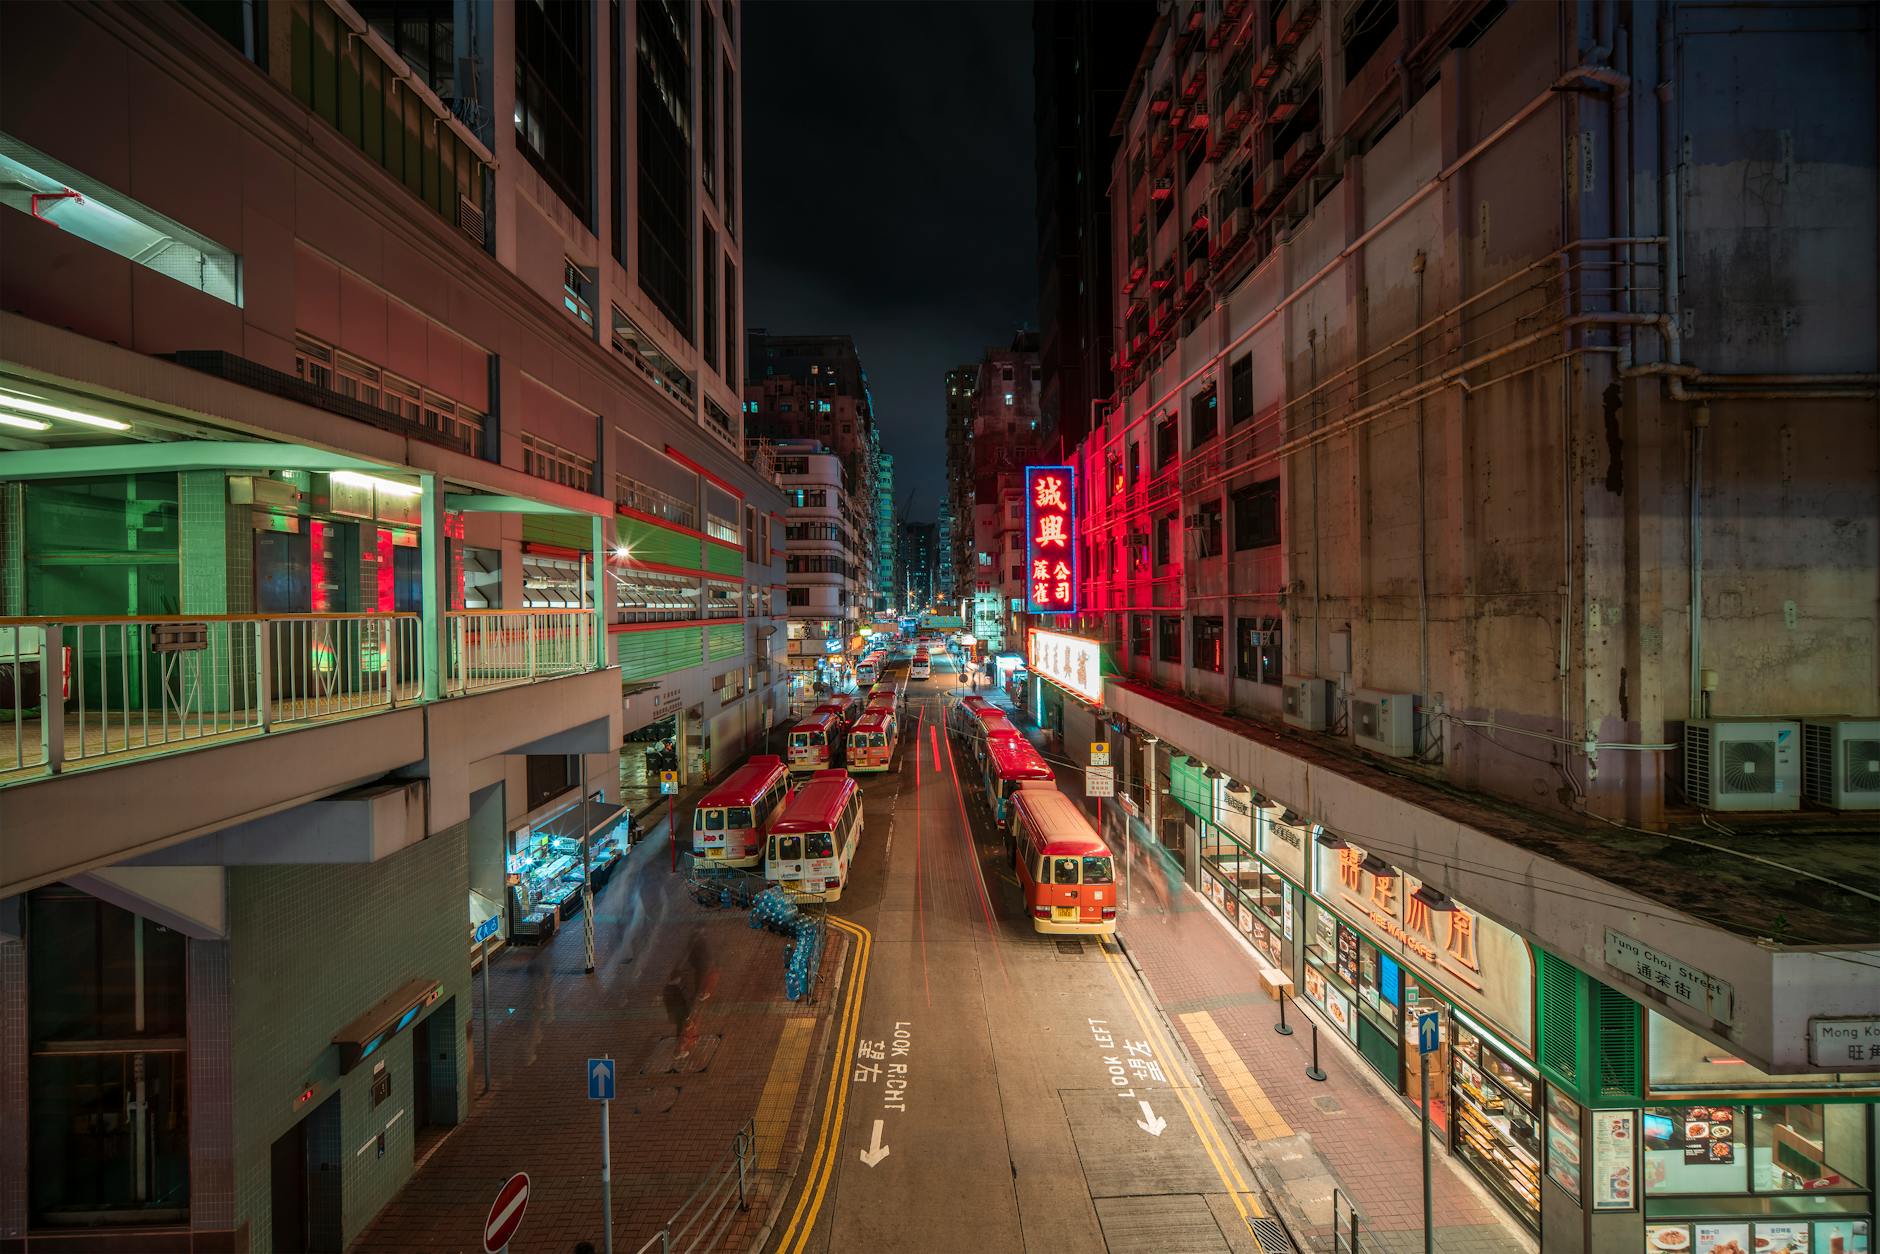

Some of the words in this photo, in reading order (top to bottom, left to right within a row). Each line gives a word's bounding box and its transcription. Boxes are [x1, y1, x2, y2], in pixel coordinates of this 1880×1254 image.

[1035, 476, 1067, 548] 誠興
[1053, 561, 1071, 603] 公司
[1387, 922, 1408, 945] WAN
[1611, 934, 1640, 956] Tung
[1644, 951, 1672, 971] Choi
[1679, 967, 1722, 996] Street
[1636, 960, 1691, 1000] 通菜街
[891, 1021, 912, 1057] LOOK
[1088, 1018, 1115, 1049] LEFT
[1822, 1027, 1858, 1040] Mong
[854, 1039, 886, 1083] 望右
[1103, 1056, 1136, 1098] LOOK
[1122, 1038, 1167, 1082] 望左
